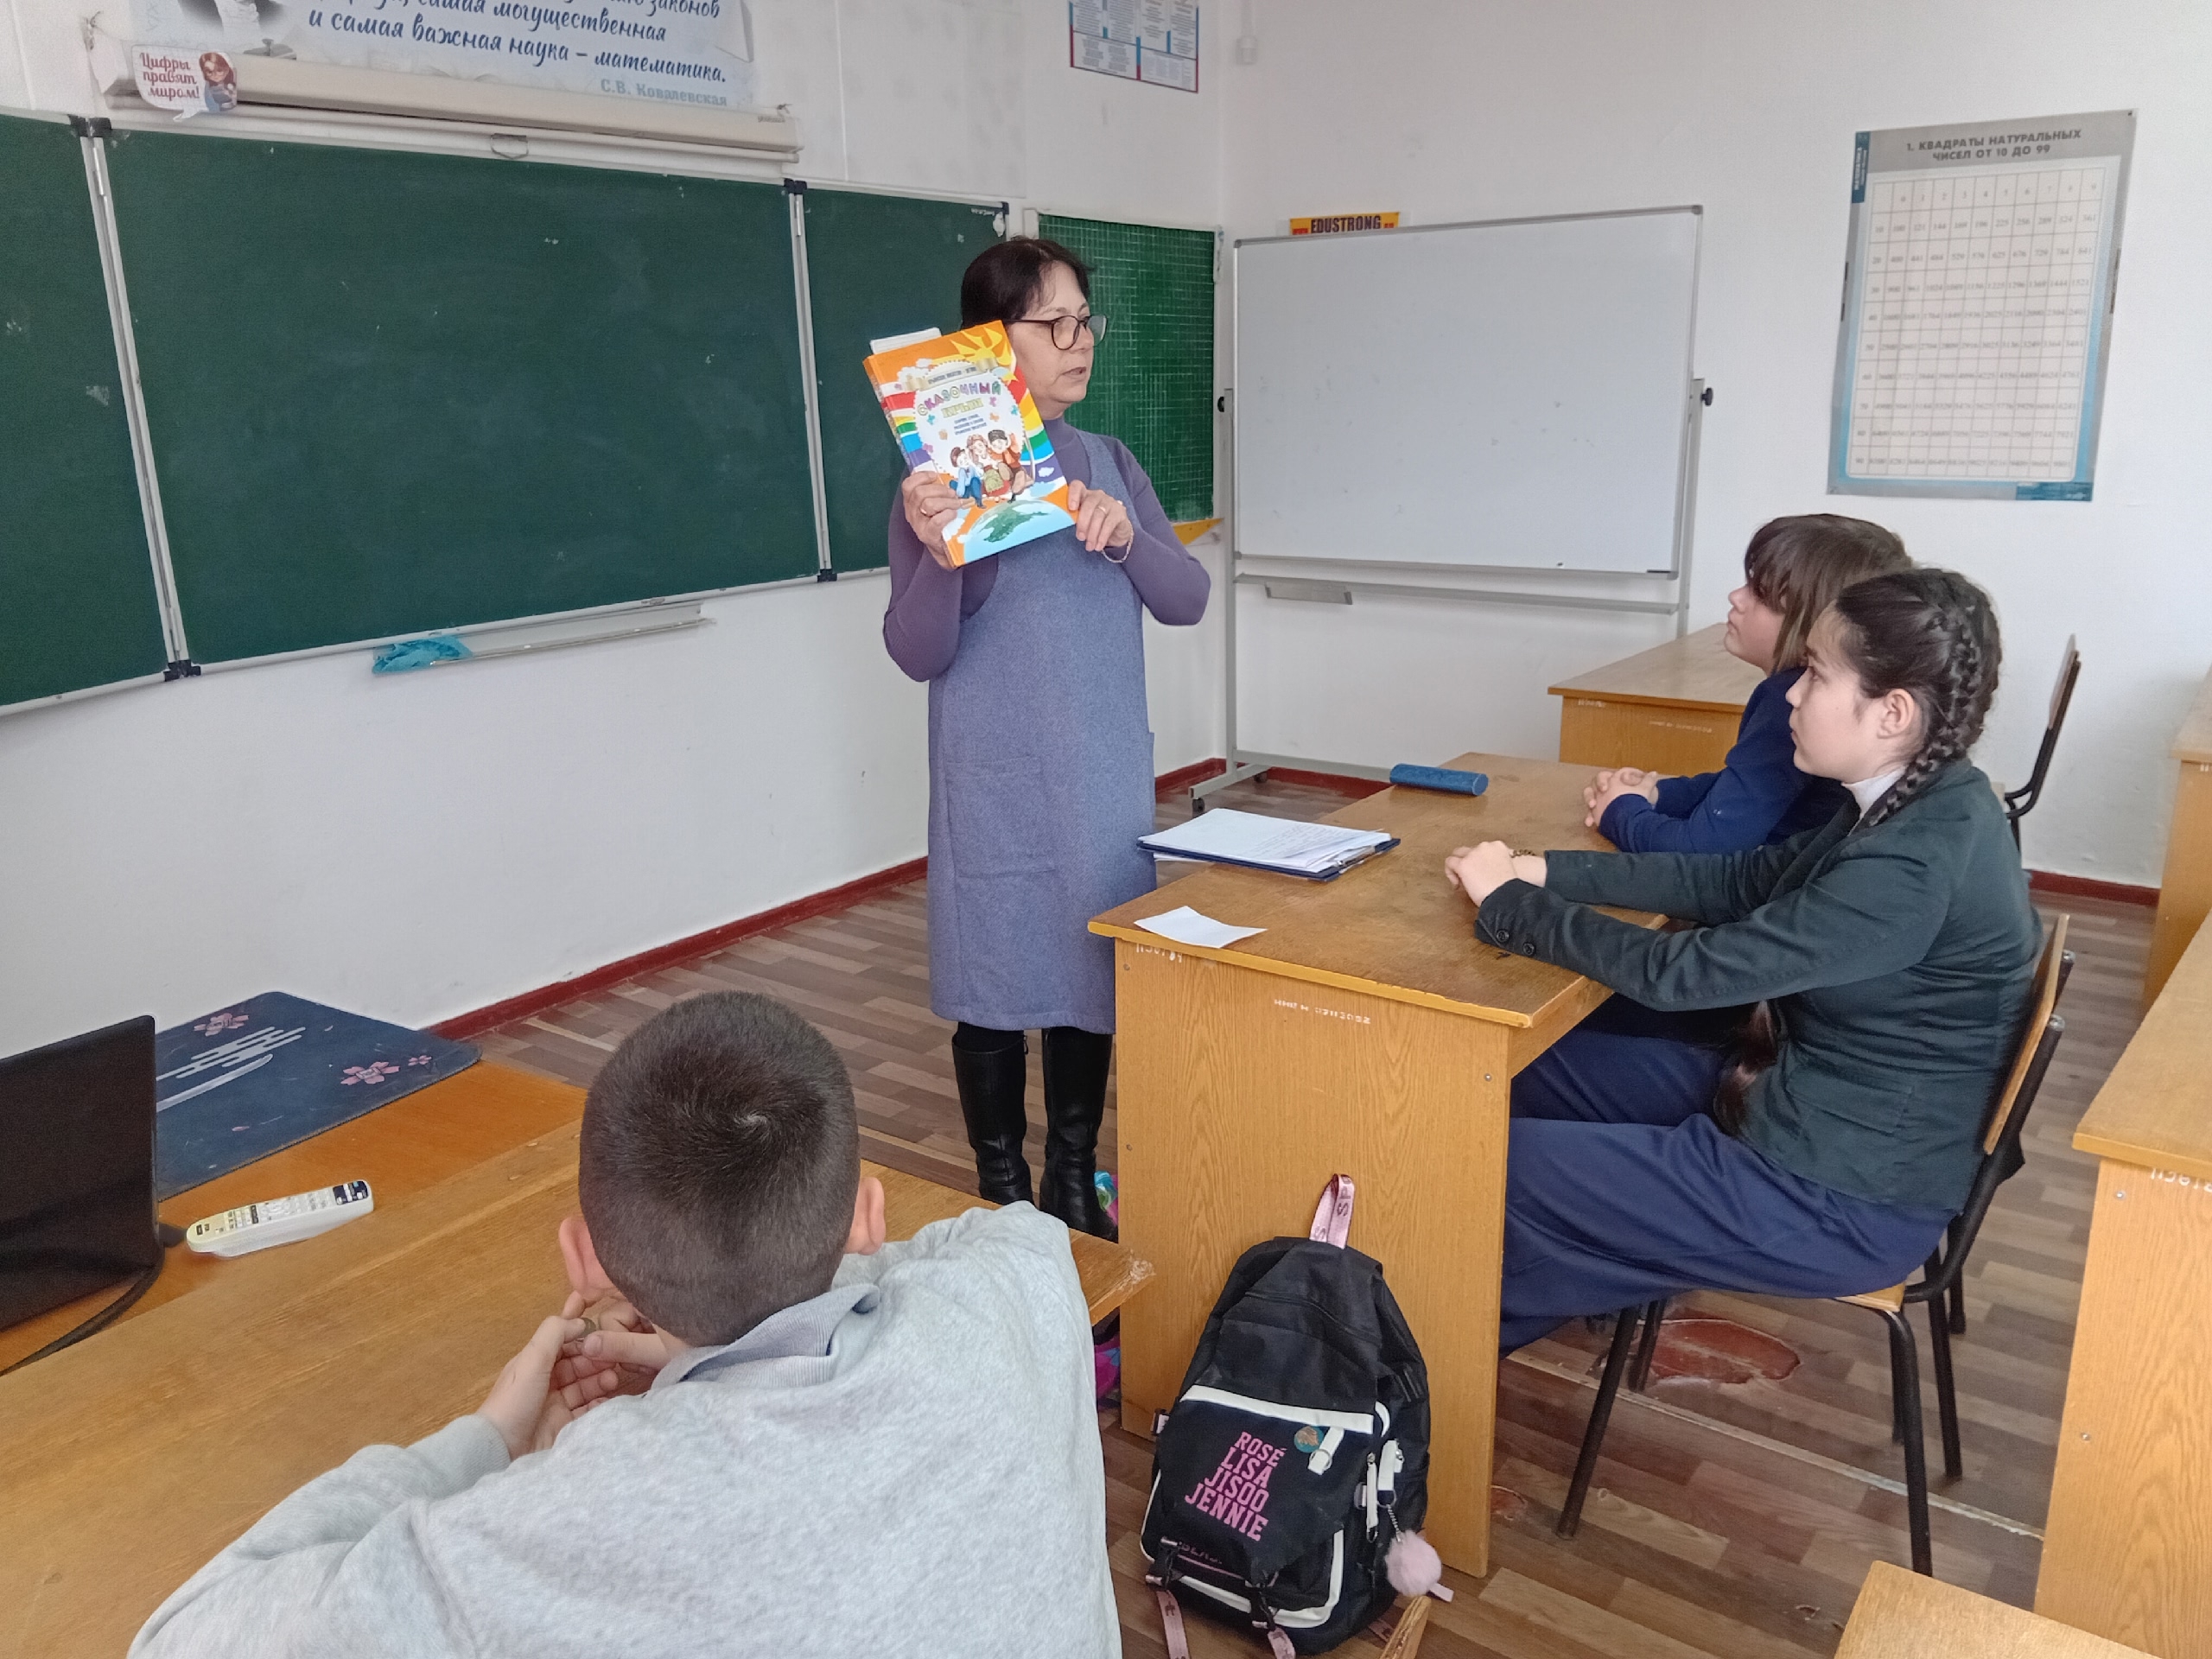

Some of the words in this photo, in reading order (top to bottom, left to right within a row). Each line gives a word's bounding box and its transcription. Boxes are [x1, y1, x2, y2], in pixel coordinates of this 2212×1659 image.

[493, 3, 667, 42] могущественная
[140, 52, 191, 73] Цифры
[308, 10, 322, 28] и
[331, 13, 404, 38] самая
[411, 12, 502, 52] важная
[509, 37, 569, 67] наука
[594, 50, 727, 83] математика.
[143, 70, 198, 86] правят
[148, 86, 200, 102] миром!
[601, 78, 632, 95] С.В.
[636, 84, 728, 107] Ковалевская
[1906, 143, 1916, 152] 1.
[1918, 137, 1985, 151] КВАДРАТЫ
[1988, 130, 2082, 146] НАТУРАЛЬНЫХ
[1932, 149, 1972, 162] ЧИСЕЛ
[1975, 149, 1993, 159] ОТ
[1996, 147, 2008, 157] 10
[2011, 146, 2032, 157] ДО
[2036, 144, 2051, 154] 99
[1311, 214, 1382, 234] EDUSTRONG
[917, 380, 1001, 416] СКАЗОЧНЫЙ
[1233, 1430, 1288, 1468] ROSÉ
[1220, 1446, 1274, 1490] LISA
[1204, 1465, 1270, 1513] JISOO
[1185, 1483, 1269, 1541] JENNIE
